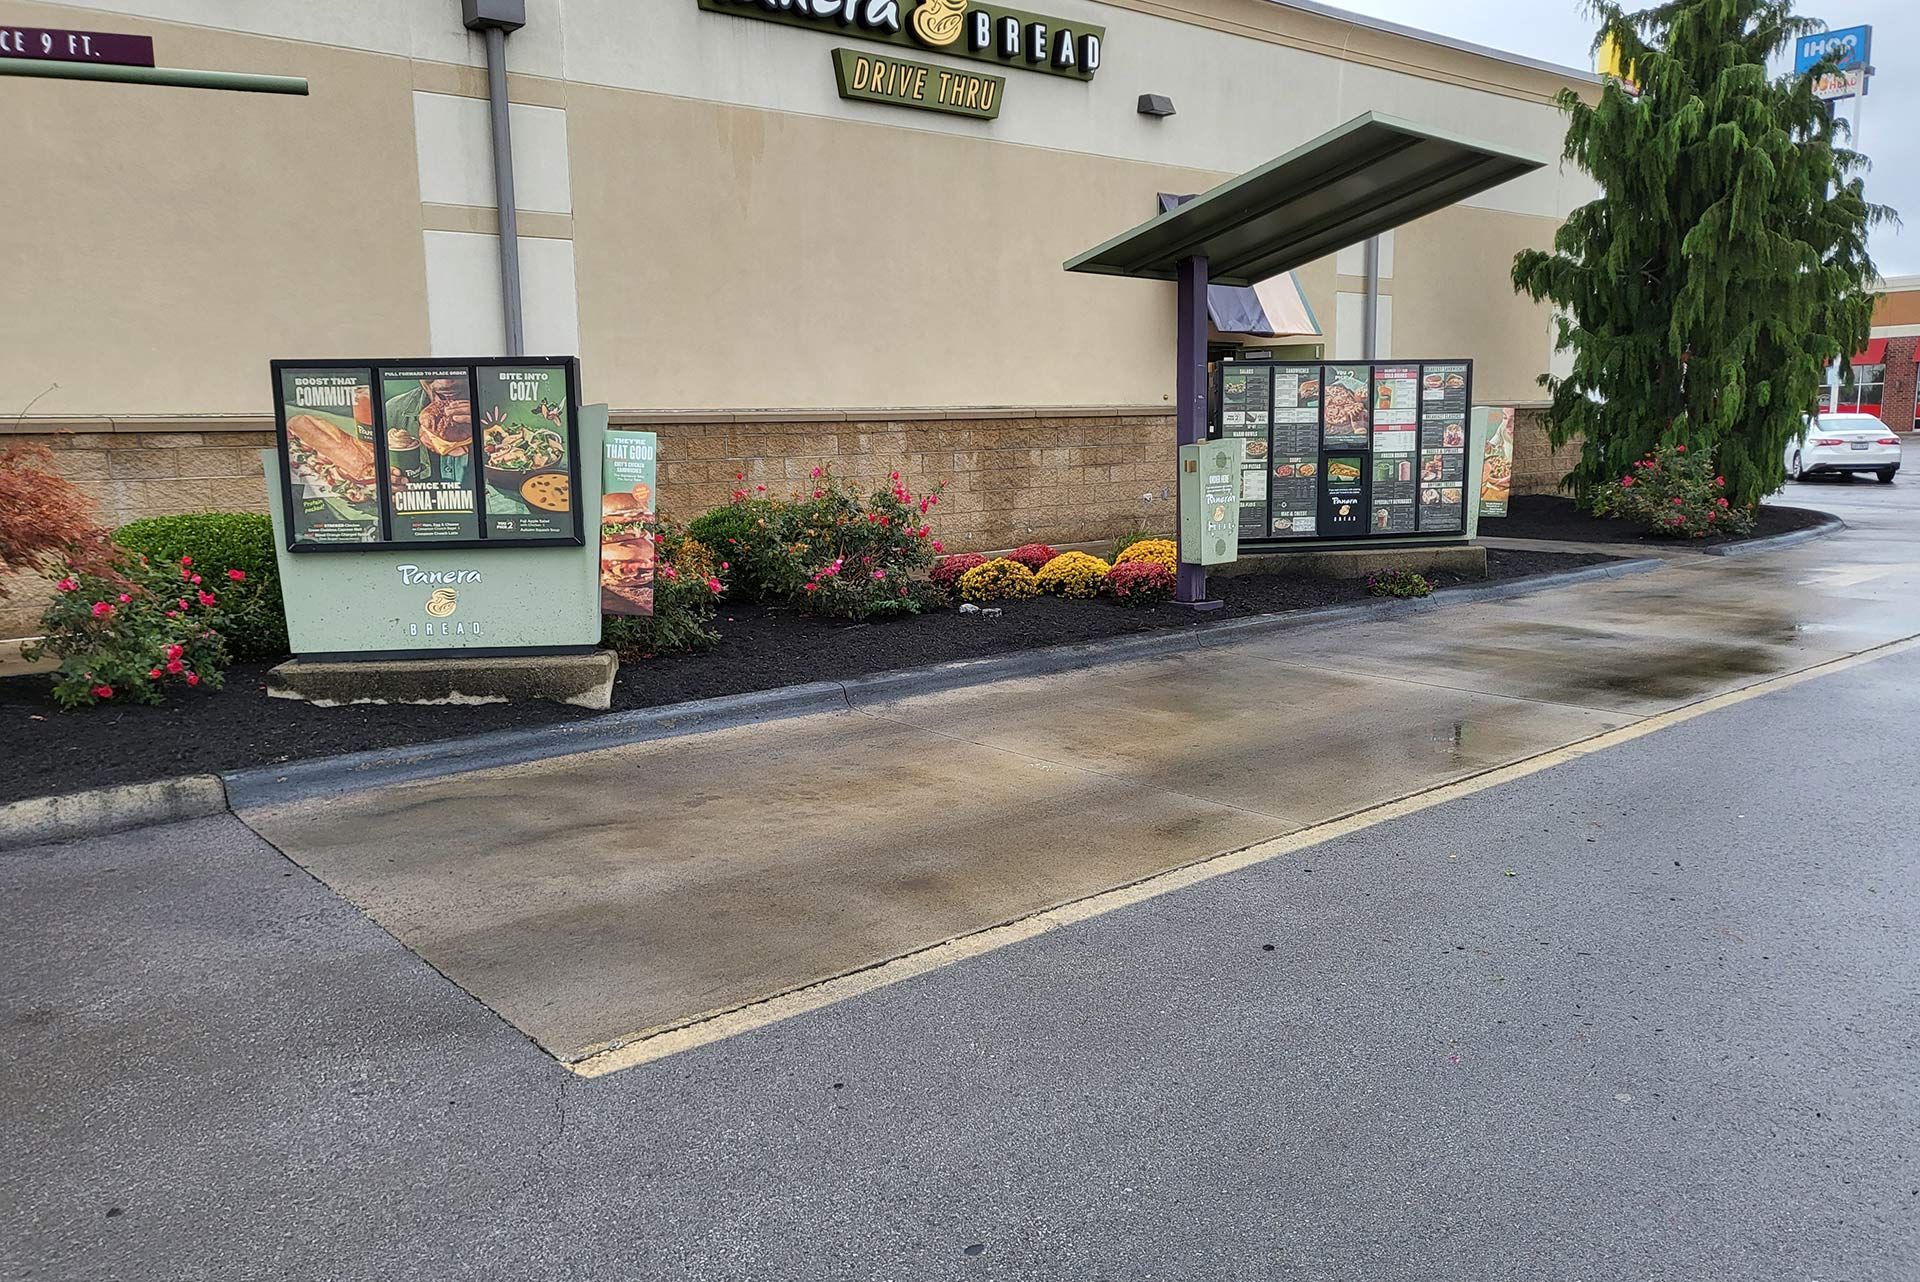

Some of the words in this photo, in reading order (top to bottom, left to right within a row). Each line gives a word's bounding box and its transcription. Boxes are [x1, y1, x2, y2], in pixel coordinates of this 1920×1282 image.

[41, 32, 53, 54] 9
[67, 34, 101, 57] FT.
[973, 11, 1100, 70] BREAD
[851, 57, 927, 101] DRIVE
[937, 72, 997, 111] THRU
[295, 378, 328, 386] BOOST
[330, 377, 357, 385] THAT
[509, 381, 539, 401] COZY
[296, 386, 358, 407] COMMUTE
[606, 444, 628, 459] THAT
[630, 446, 653, 461] GOOD
[406, 482, 439, 490] TWICE
[395, 490, 474, 511] CINNA-MMM
[1332, 496, 1358, 505] Panera
[507, 521, 514, 529] 2
[397, 565, 482, 585] Panera
[409, 621, 481, 636] BREAD
